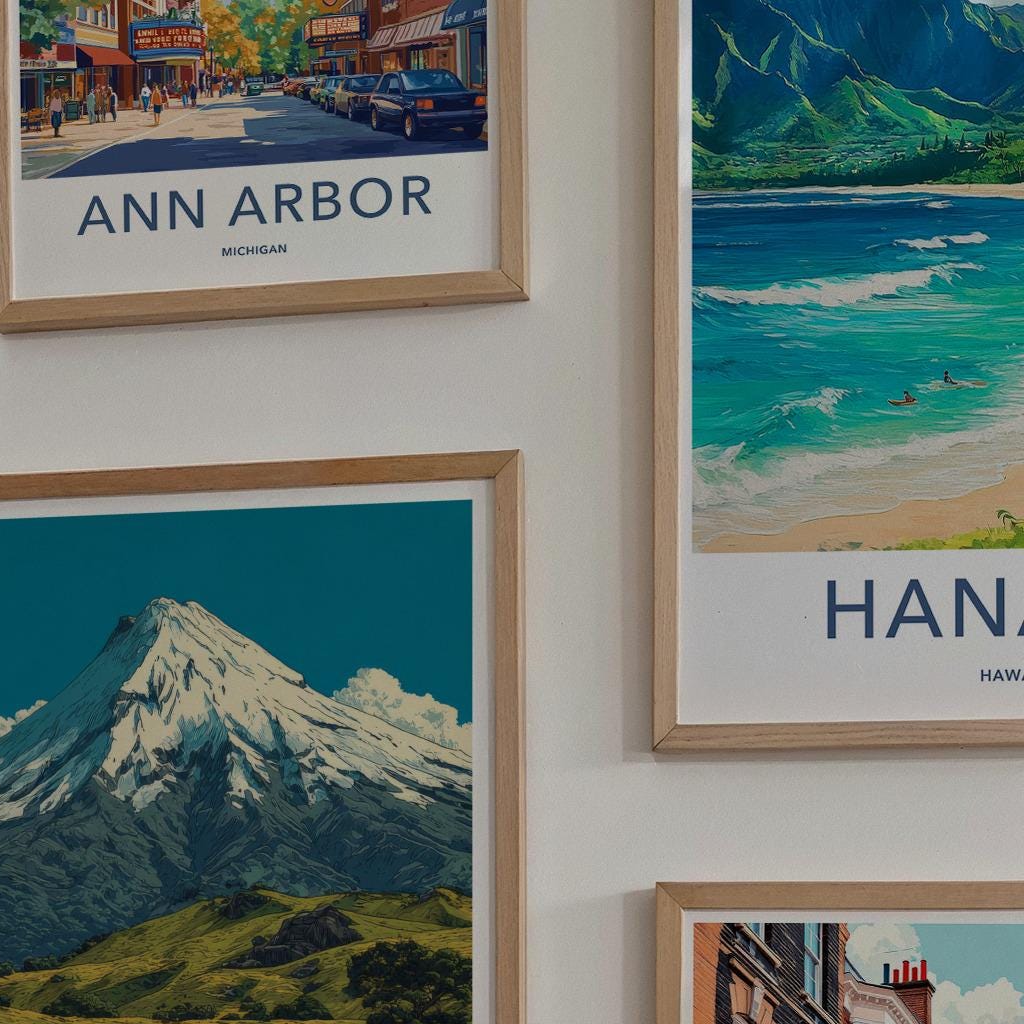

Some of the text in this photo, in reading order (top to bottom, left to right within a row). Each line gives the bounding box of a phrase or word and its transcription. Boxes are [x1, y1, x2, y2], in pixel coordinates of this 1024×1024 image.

[77, 175, 432, 236] ANN ARBOR
[221, 243, 288, 257] MICHIGAN
[827, 577, 1024, 639] HAN
